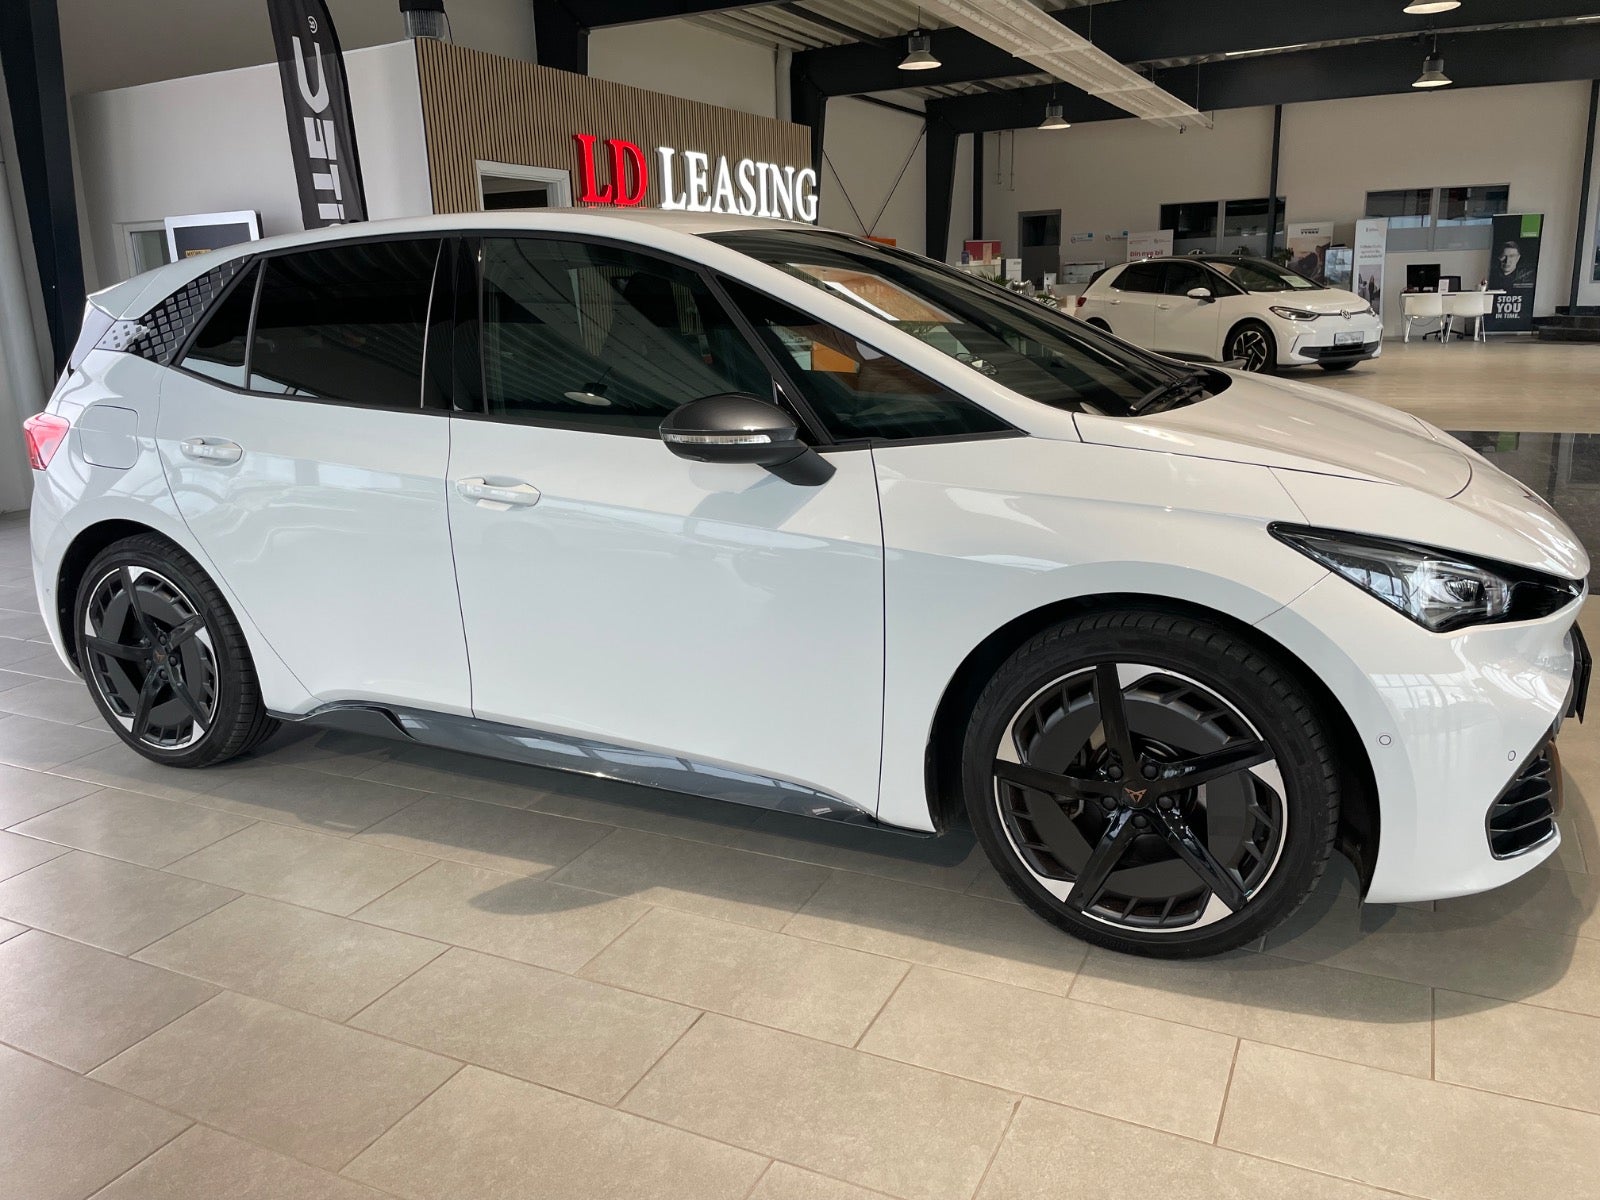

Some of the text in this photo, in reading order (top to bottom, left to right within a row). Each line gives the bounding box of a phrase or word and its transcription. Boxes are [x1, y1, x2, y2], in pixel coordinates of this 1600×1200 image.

[573, 133, 819, 223] LD LEASING
[1497, 302, 1521, 313] YOU
